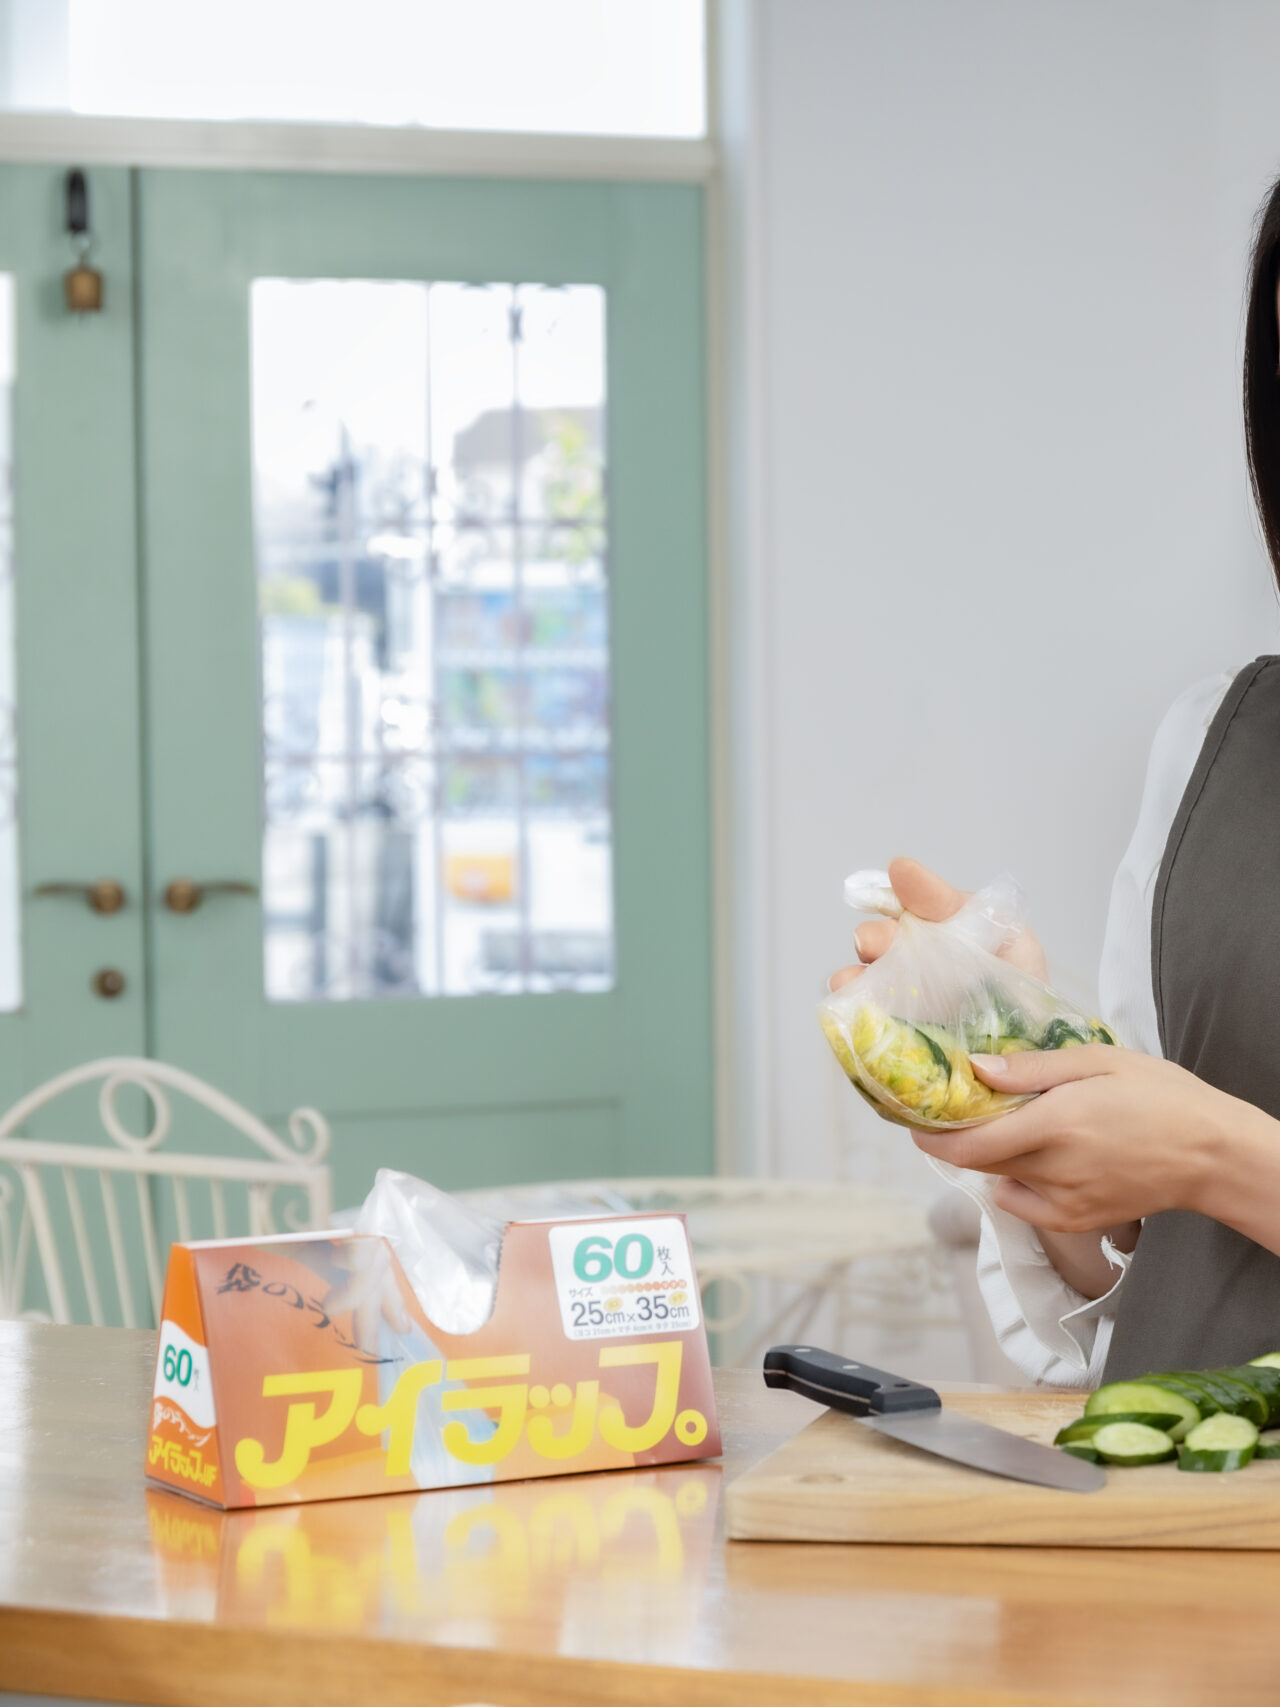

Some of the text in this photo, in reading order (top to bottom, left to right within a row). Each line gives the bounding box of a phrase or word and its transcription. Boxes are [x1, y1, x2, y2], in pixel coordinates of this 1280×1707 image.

[573, 1233, 675, 1283] 60 枚入
[568, 1286, 594, 1299] サイズ
[163, 1343, 193, 1387] 60
